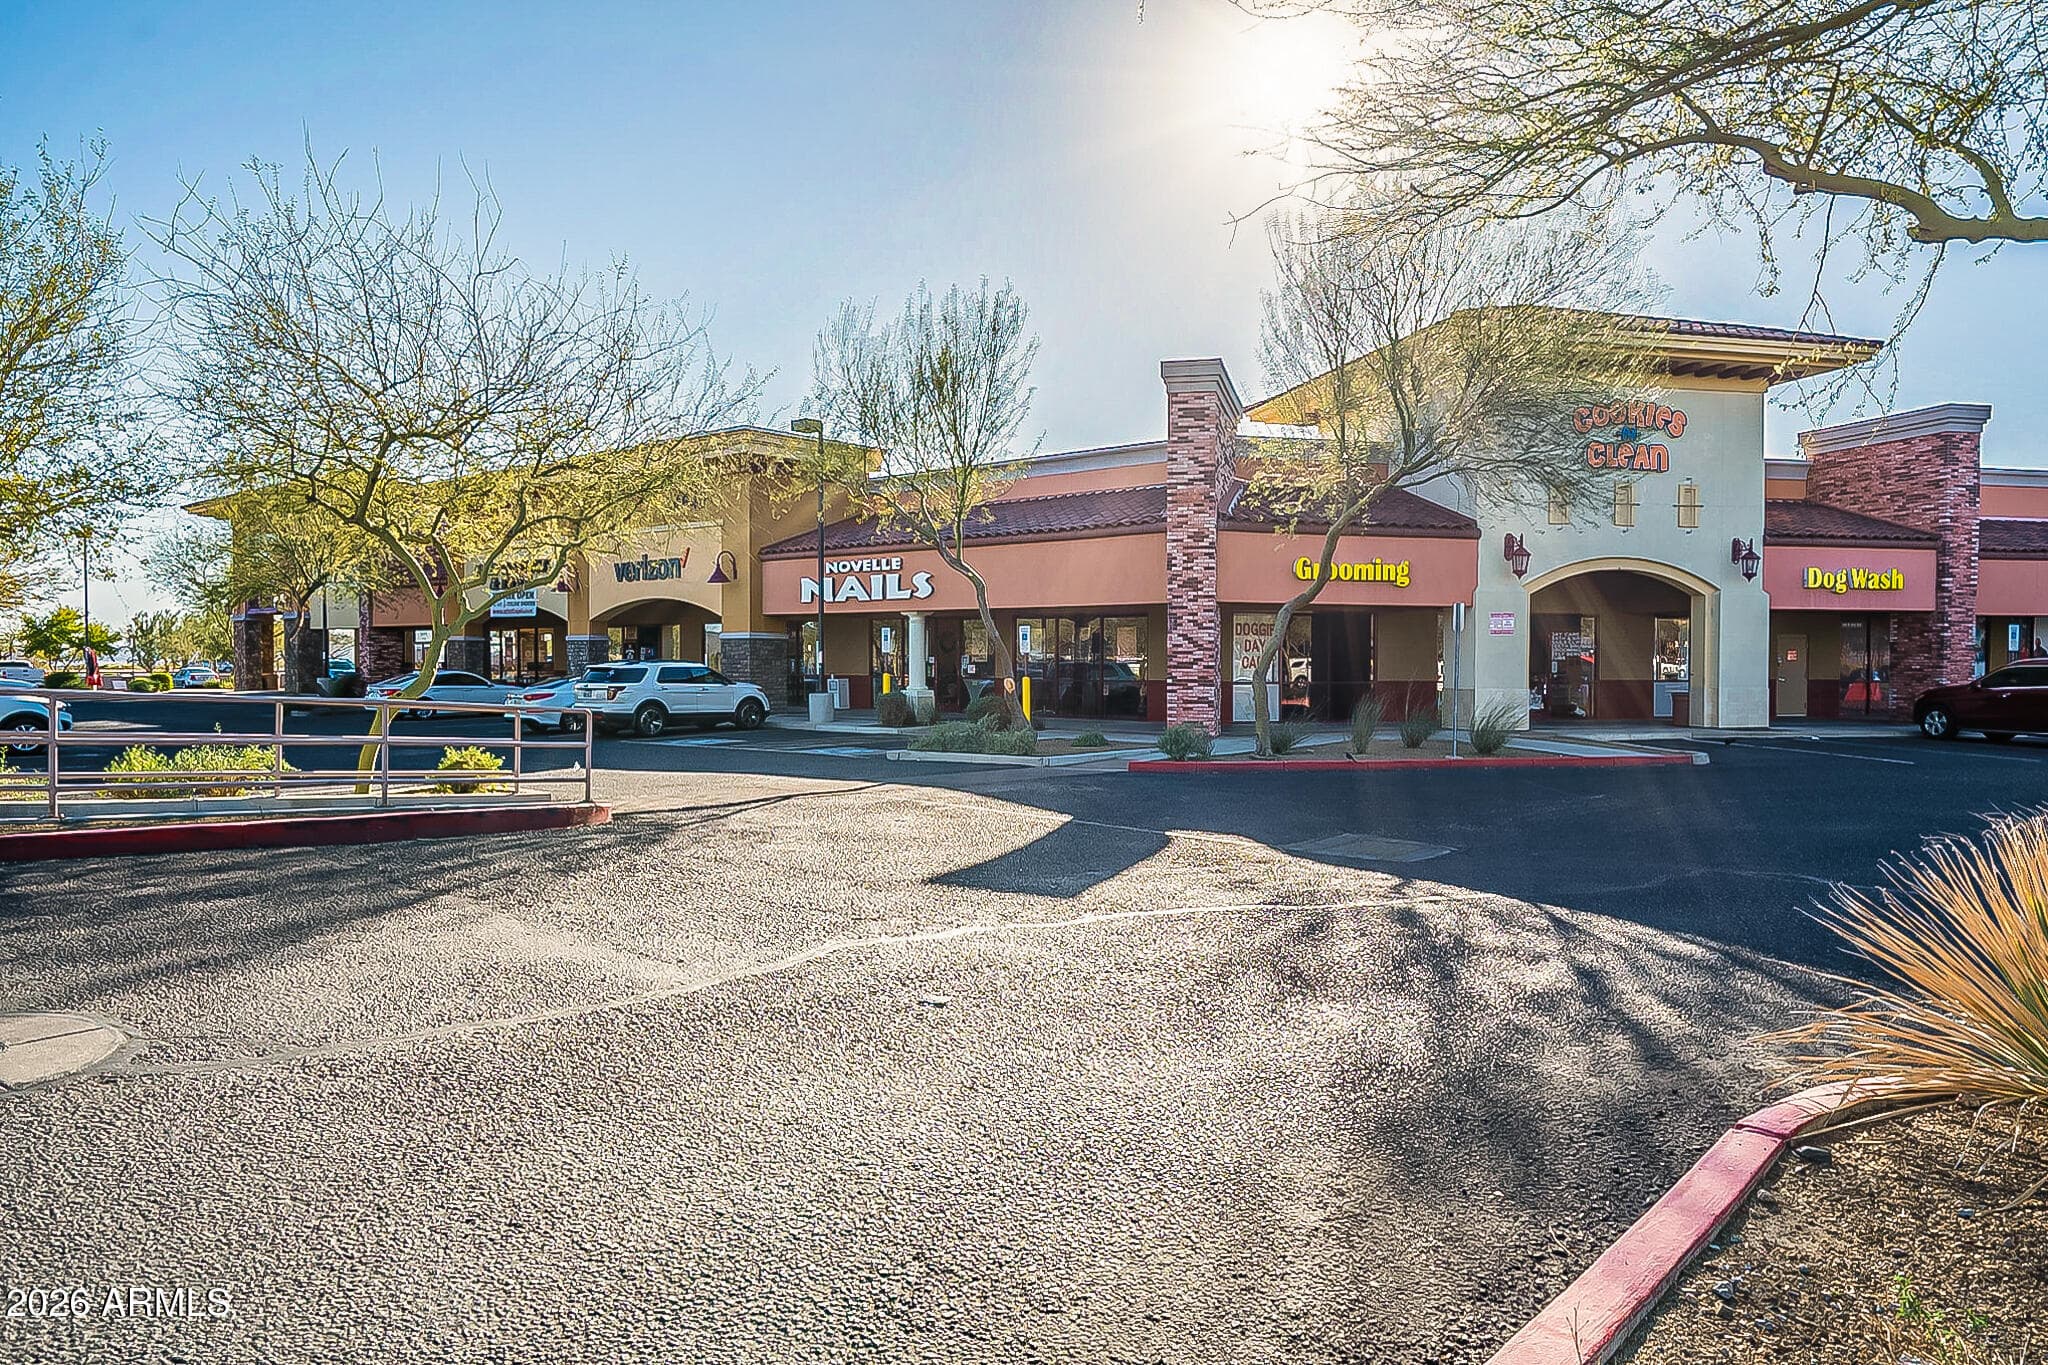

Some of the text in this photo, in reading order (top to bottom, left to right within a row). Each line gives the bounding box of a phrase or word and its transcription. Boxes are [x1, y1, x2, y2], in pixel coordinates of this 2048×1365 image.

[613, 553, 682, 582] verizon
[825, 557, 903, 574] NOVELLE
[1293, 556, 1411, 588] Grooming
[800, 572, 935, 604] NAILS
[1804, 567, 1904, 594] Dog Wash
[1244, 638, 1266, 653] DAY
